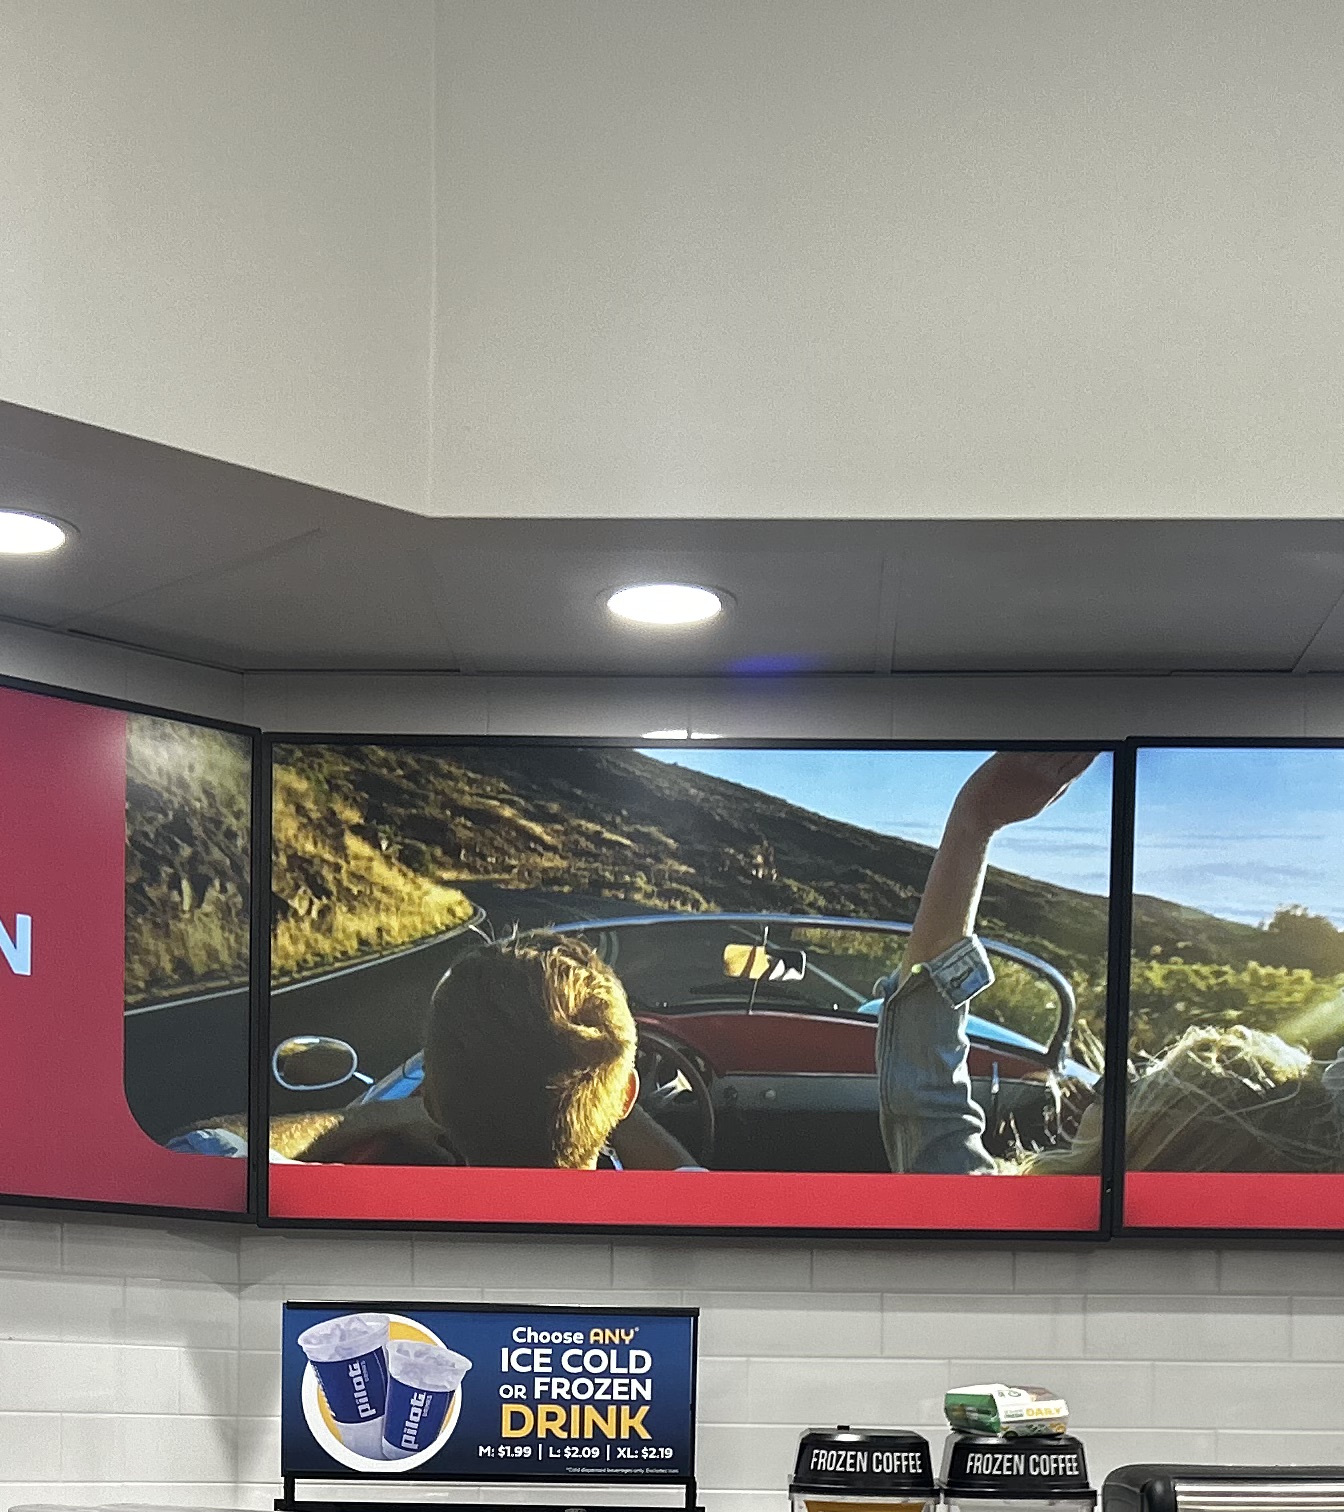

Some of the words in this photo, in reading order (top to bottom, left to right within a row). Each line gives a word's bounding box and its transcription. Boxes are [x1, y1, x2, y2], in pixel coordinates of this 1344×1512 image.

[512, 1327, 584, 1344] Choose
[500, 1348, 552, 1374] ICE
[561, 1348, 653, 1375] COLD
[349, 1360, 376, 1418] pilot
[499, 1385, 526, 1399] OR
[535, 1377, 653, 1400] FROZEN
[401, 1392, 425, 1449] pilot
[501, 1404, 653, 1440] DRINK
[478, 1446, 495, 1457] M:
[498, 1446, 532, 1458] $1.99
[549, 1447, 561, 1458] L:
[564, 1447, 599, 1459] $2.09
[617, 1447, 638, 1458] XL:
[641, 1447, 673, 1459] $2.19
[811, 1450, 868, 1473] FROZEN
[872, 1452, 923, 1474] COFFEE
[966, 1453, 1025, 1475] FROZEN
[1028, 1454, 1079, 1476] COFFEE
